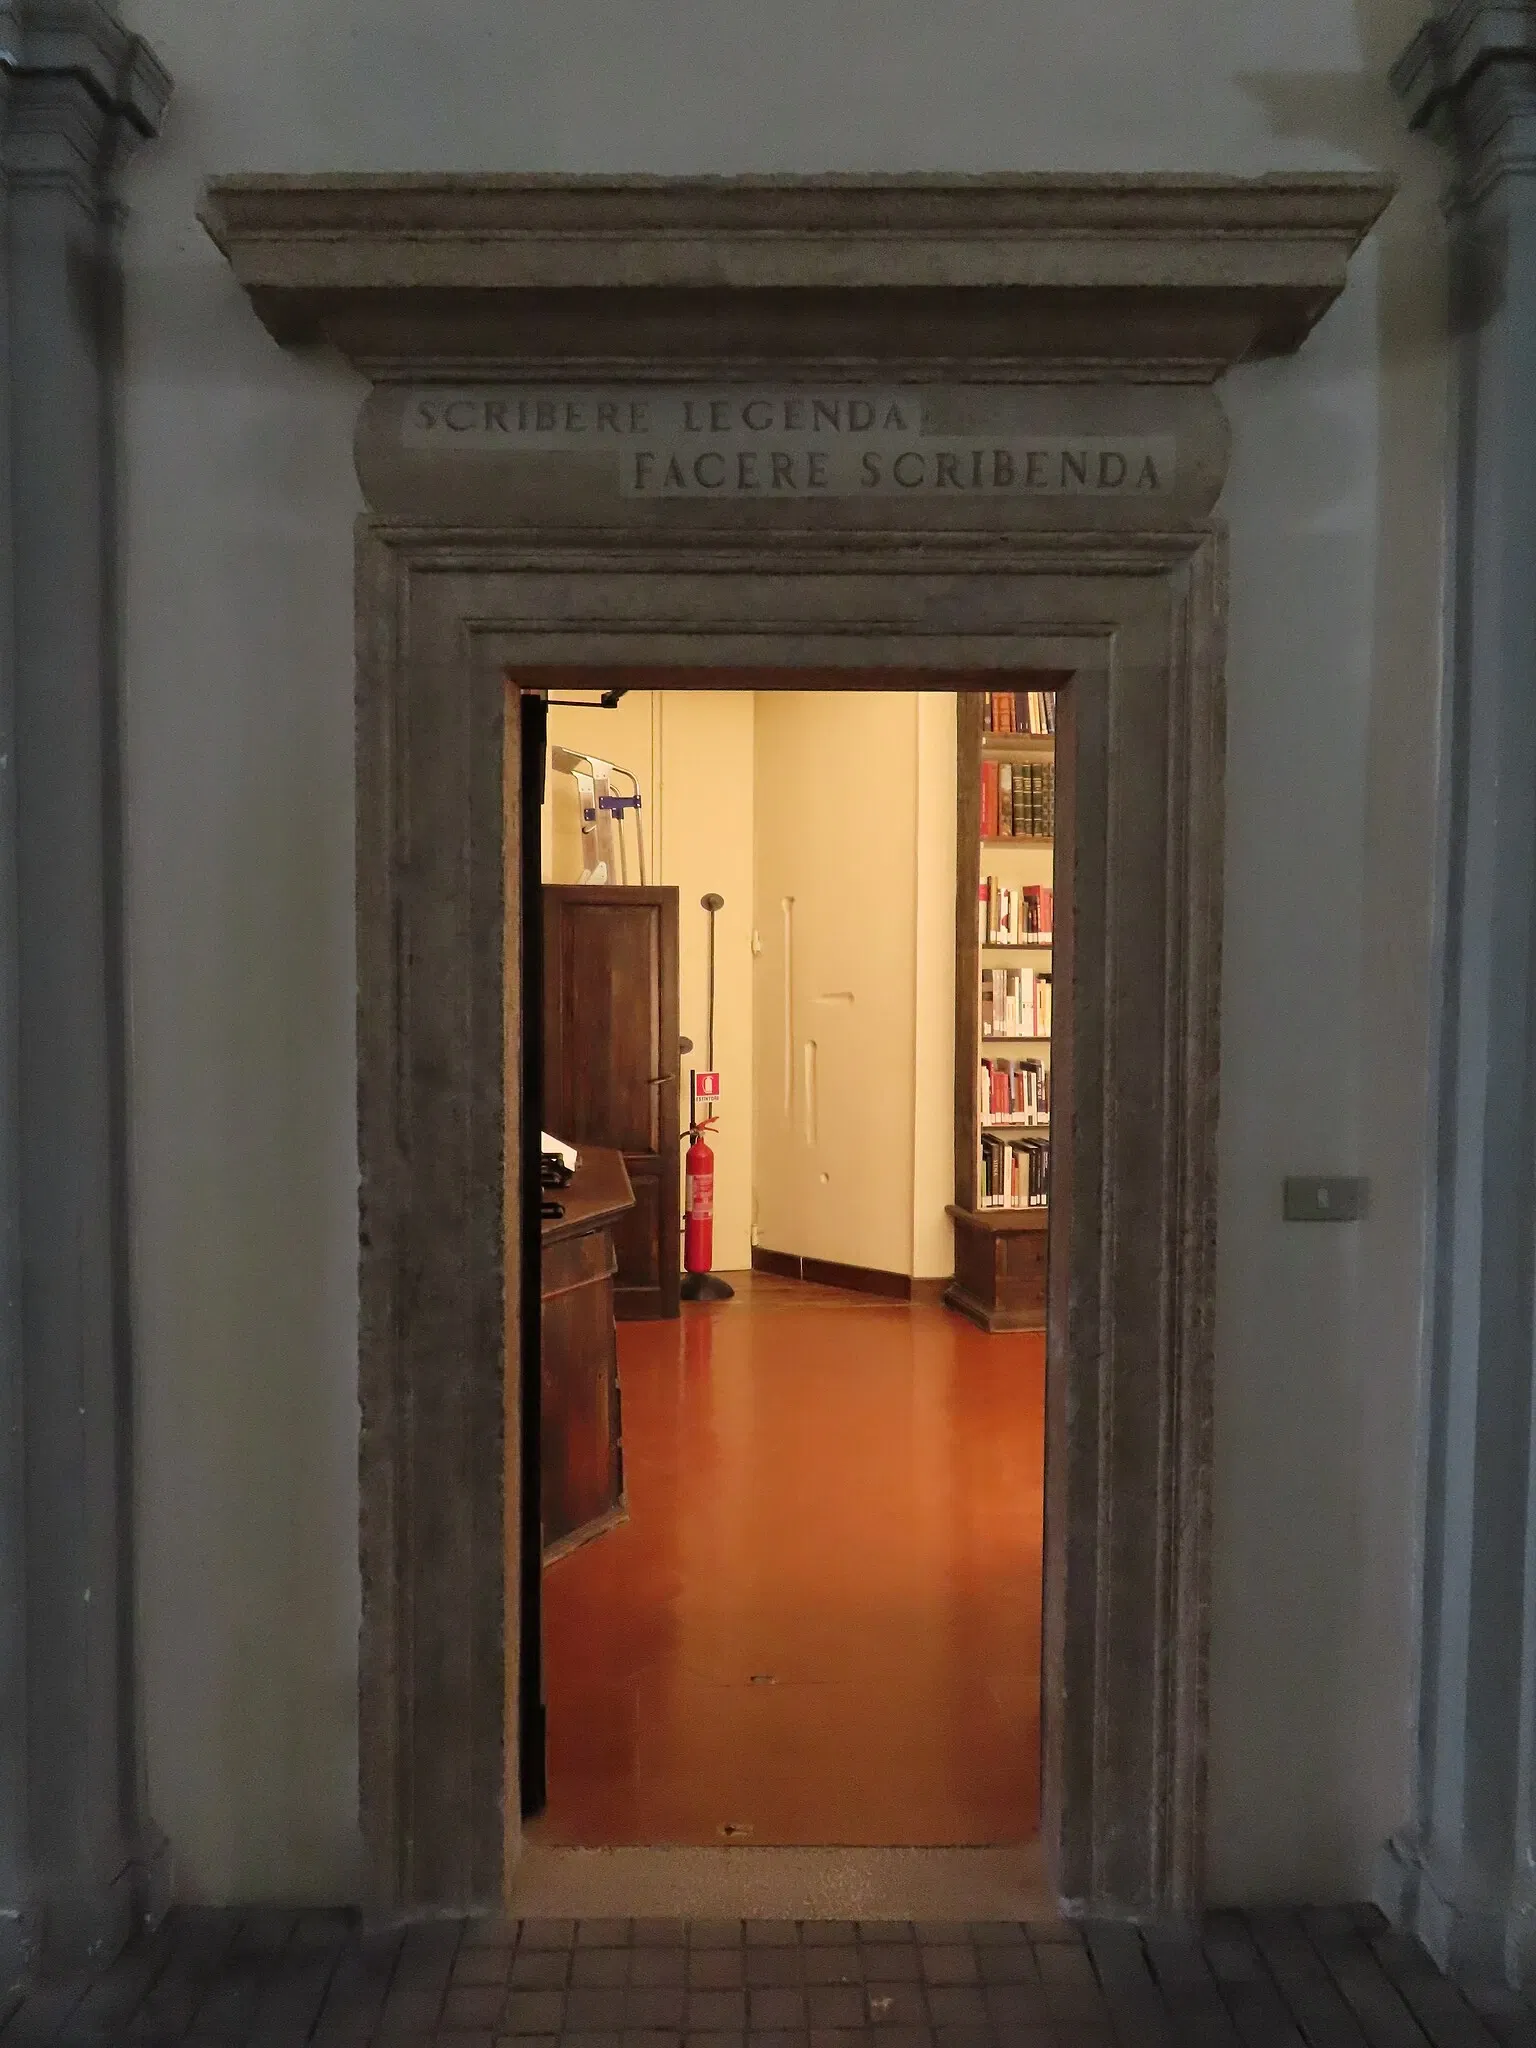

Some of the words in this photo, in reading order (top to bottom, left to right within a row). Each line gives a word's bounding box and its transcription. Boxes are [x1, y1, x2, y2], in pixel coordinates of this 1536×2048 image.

[417, 400, 649, 433] SCRIBERE
[682, 399, 908, 433] LEGENDA
[634, 451, 828, 489] FACERE
[860, 449, 1160, 489] SCRIBENDA
